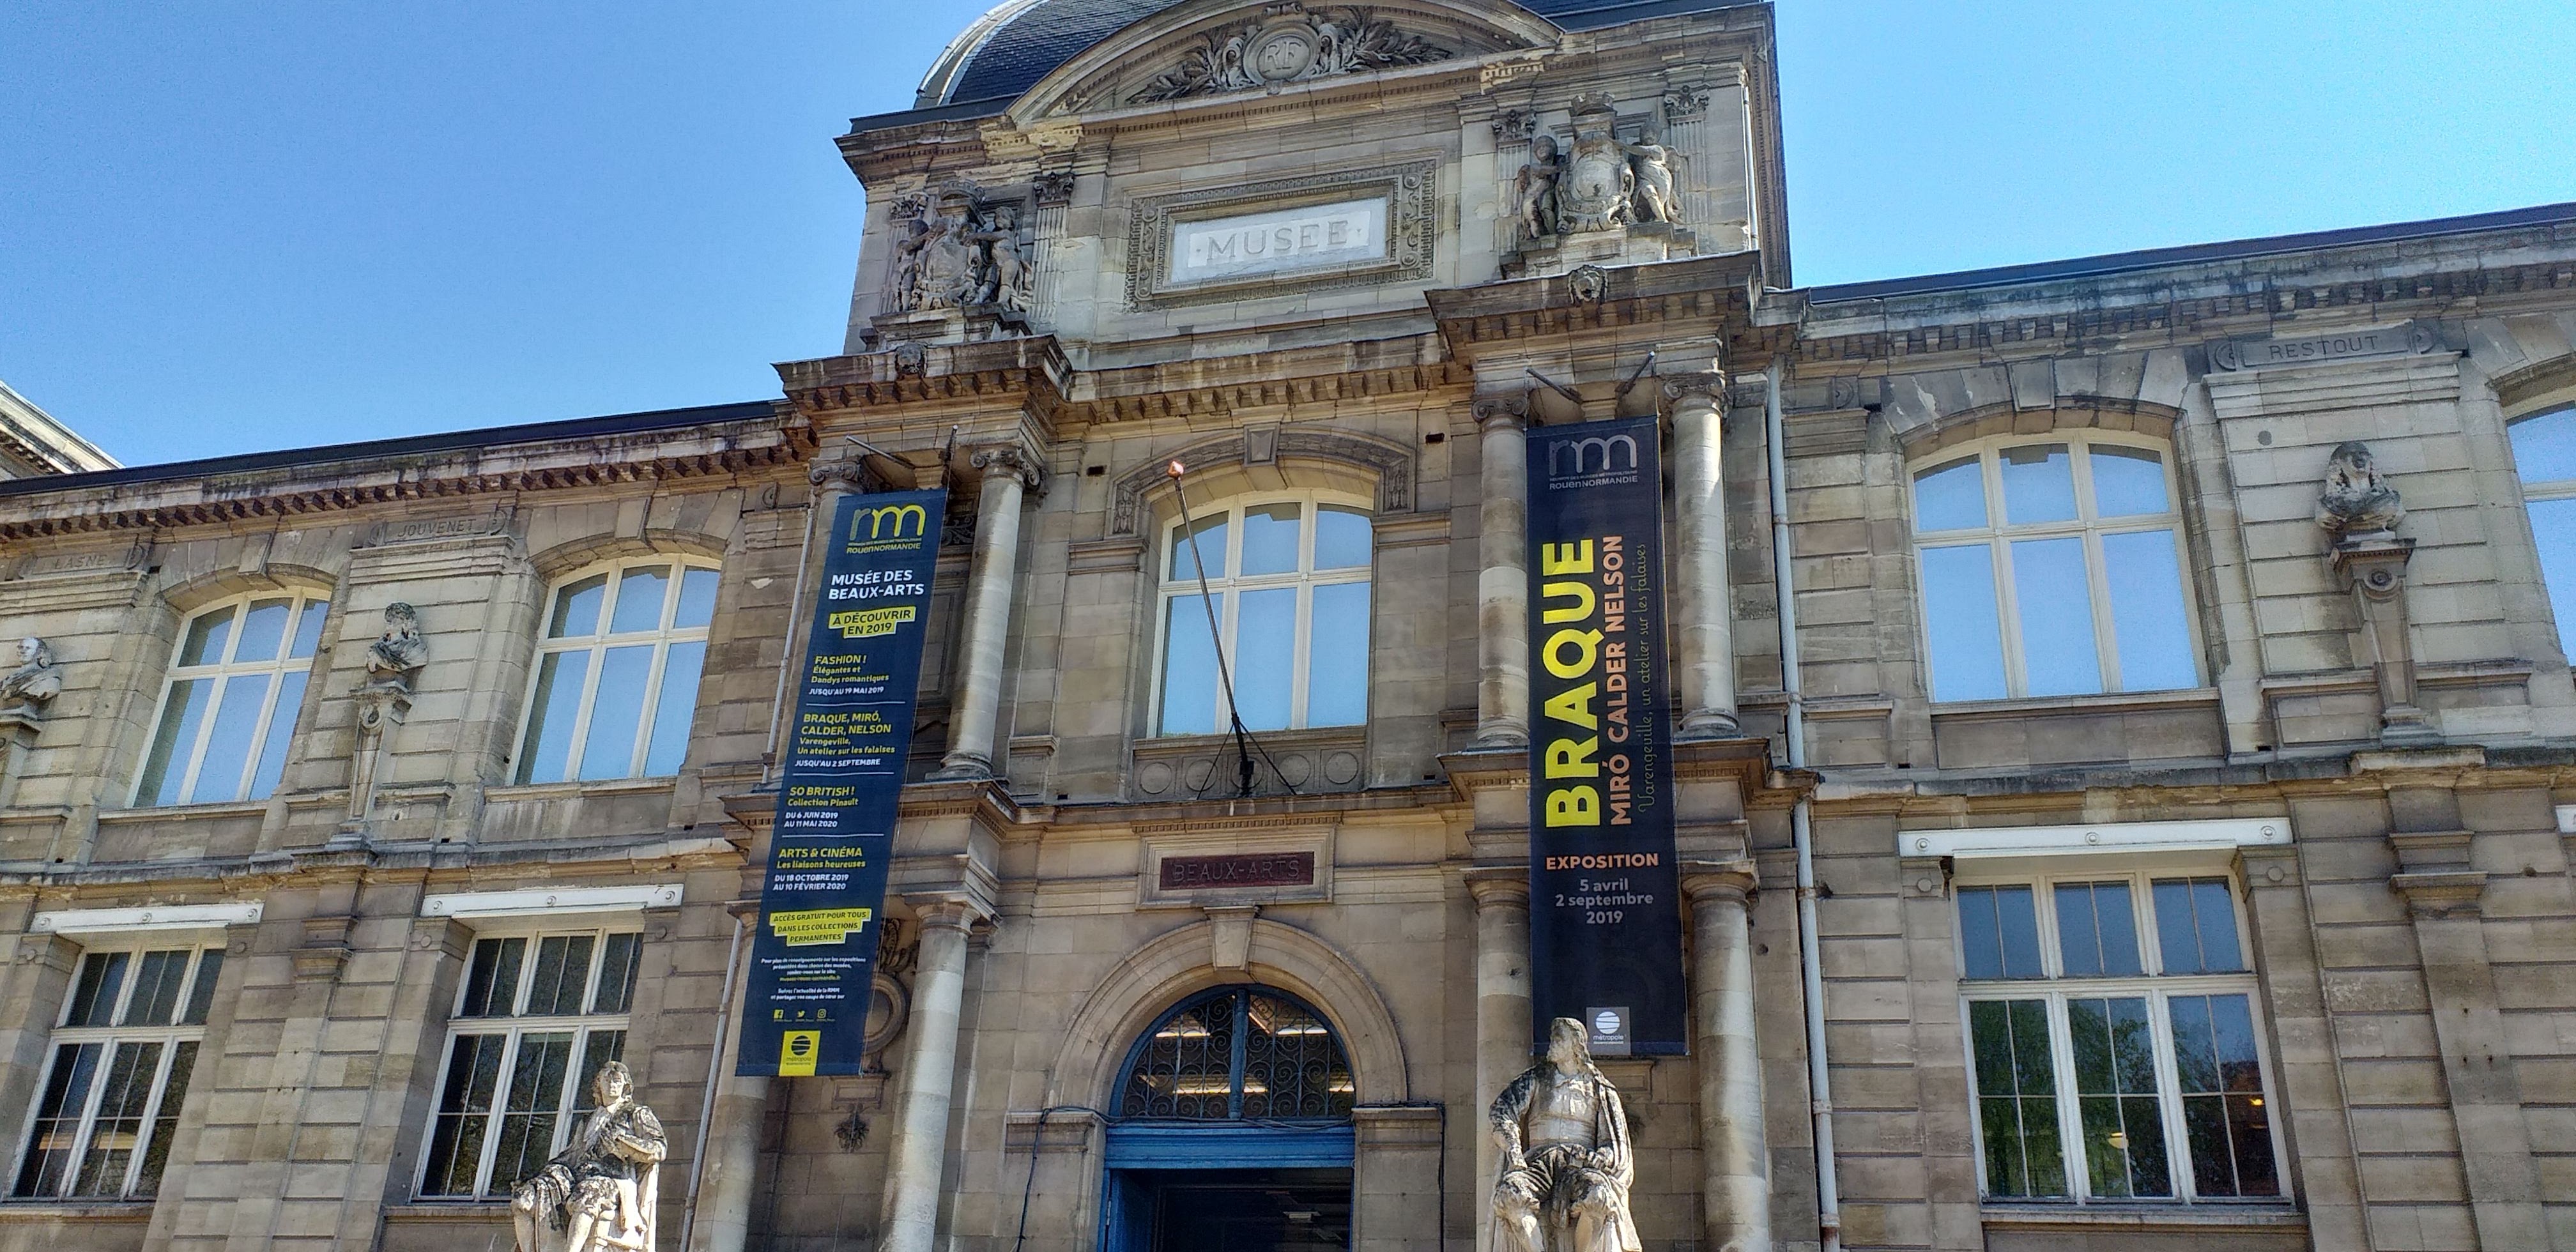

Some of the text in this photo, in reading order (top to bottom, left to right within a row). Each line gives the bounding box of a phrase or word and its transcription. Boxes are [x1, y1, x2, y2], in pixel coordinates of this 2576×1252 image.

[1207, 220, 1349, 260] MUSEE
[2269, 335, 2378, 360] RESTOUT
[397, 519, 477, 537] JOUVENET
[55, 554, 107, 570] LASNE
[831, 570, 913, 586] MUSÉE DES
[829, 583, 924, 600] BEAUX-ARTS
[832, 609, 911, 625] À DÉCOUVRIR
[847, 622, 892, 634] EN 2019
[815, 655, 861, 665] FASHION
[813, 665, 850, 676] Élégantes
[811, 675, 889, 685] Dandys romantiques
[1542, 539, 1605, 827] BRAQUE
[1602, 536, 1631, 825] MIRÓ CALDER NELSON
[1630, 544, 1657, 813] Varengeville, un atelier sur les falaises
[809, 687, 844, 696] JUSQU'AU
[803, 710, 881, 724] BRAQUE, MIRÓ,
[801, 724, 892, 736] CALDER, NELSON
[799, 737, 851, 746] Varengeville,
[809, 747, 837, 755] atelier
[795, 760, 831, 768] JUSQU'AU
[838, 758, 881, 767] SEPTEMBRE
[790, 787, 805, 796] SO
[806, 786, 849, 797] BRITISH
[788, 798, 859, 807] Collection Pinault
[779, 846, 862, 858] ARTS & CINÉMA
[824, 860, 866, 868] heureuses
[1545, 853, 1659, 870] EXPOSITION
[1173, 859, 1300, 882] BEAUX-ARTS
[793, 882, 825, 890] FÉVRIER
[1579, 878, 1629, 892] 5 avril
[1555, 894, 1653, 909] 2 septembre
[774, 913, 795, 922] ACCÈS
[1586, 910, 1623, 924] 2019
[811, 922, 858, 931] COLLECTIONS
[790, 933, 841, 942] PERMANENTES
